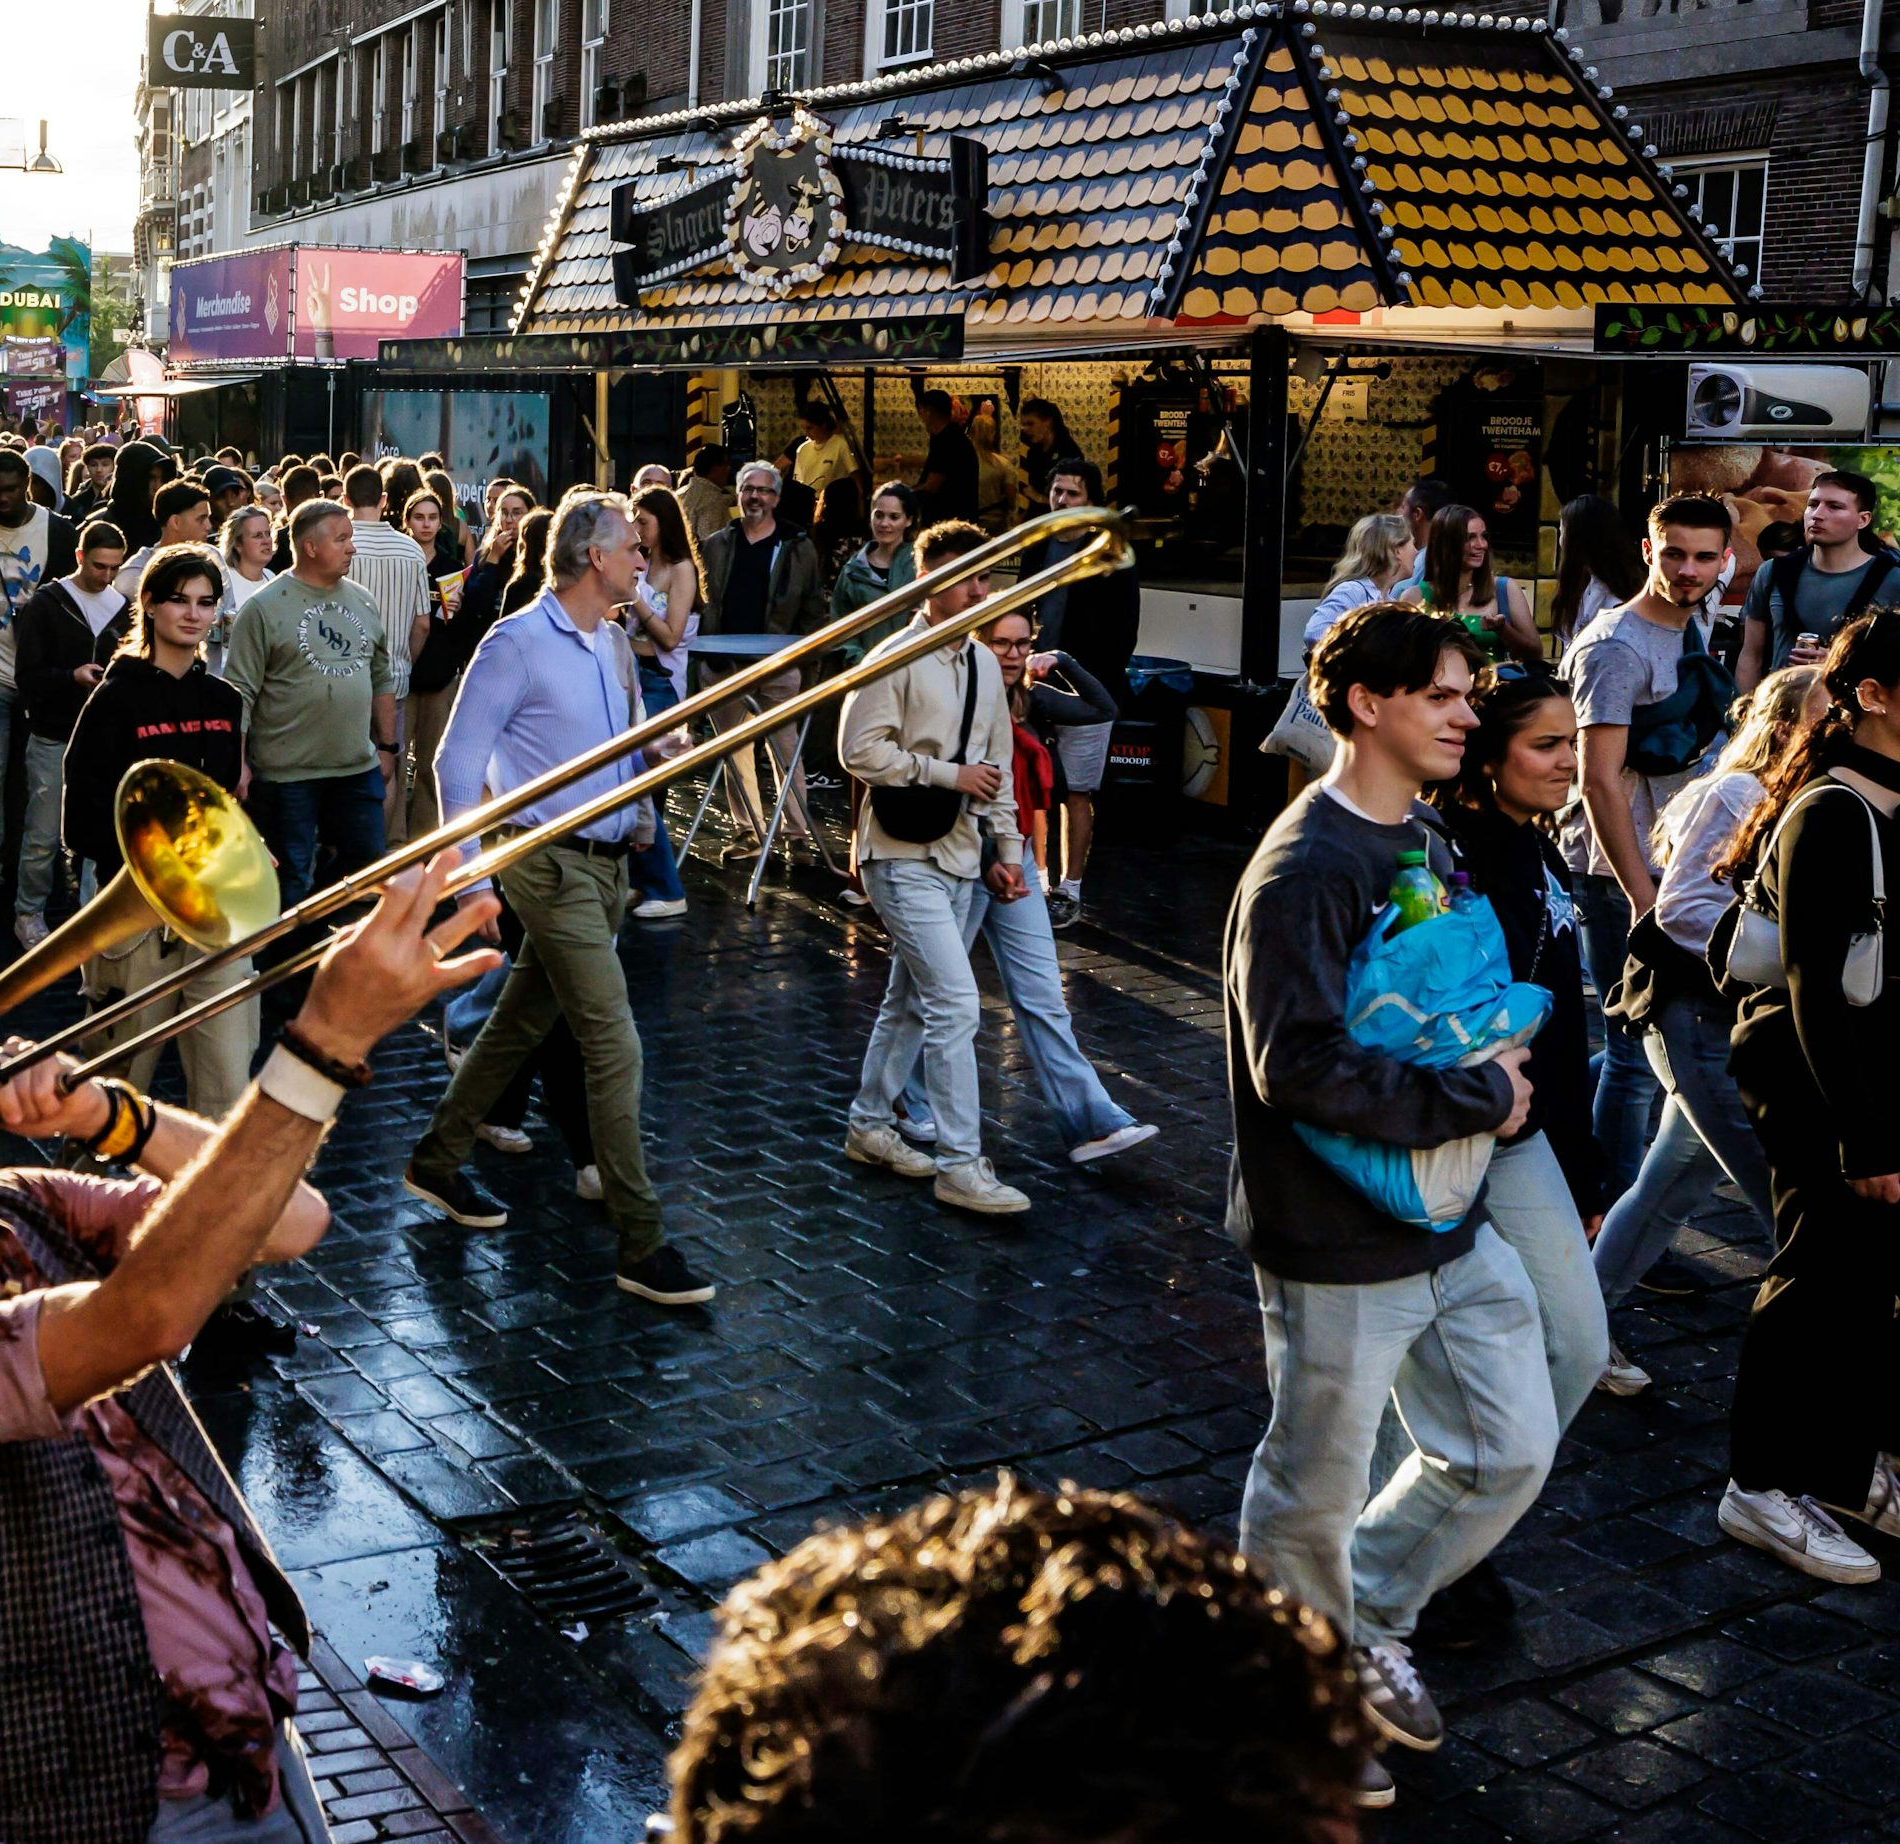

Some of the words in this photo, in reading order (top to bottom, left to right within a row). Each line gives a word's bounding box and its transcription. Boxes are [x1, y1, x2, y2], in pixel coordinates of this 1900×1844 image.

[163, 30, 240, 75] C&A
[861, 166, 958, 231] Peters
[0, 292, 60, 309] DUBAI
[196, 291, 251, 318] Merchandise
[340, 287, 419, 322] Shop
[1482, 426, 1541, 436] TWENTEHAM
[1491, 417, 1533, 425] BROODJE
[318, 620, 351, 657] 1982
[1111, 745, 1152, 757] STOP
